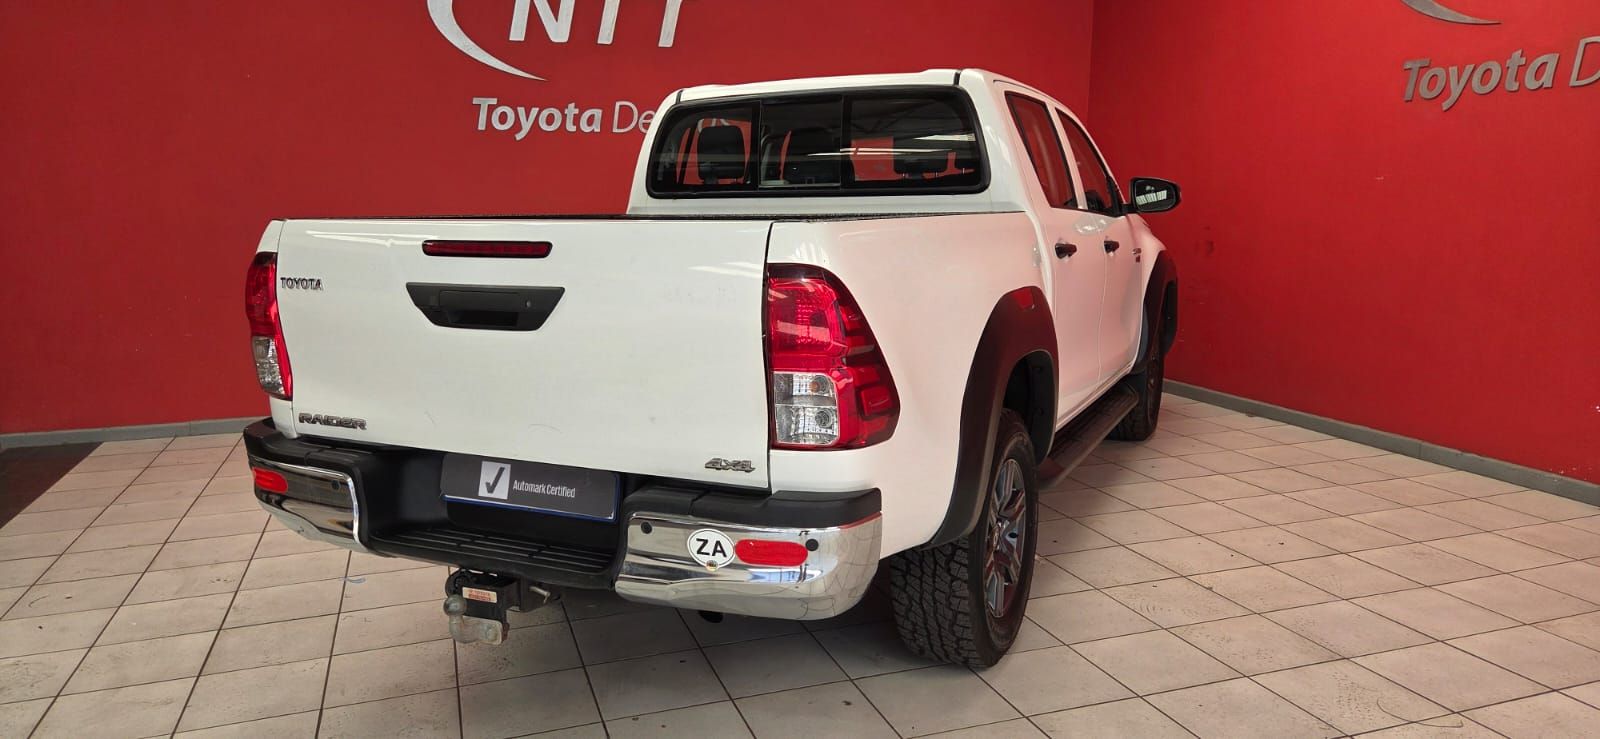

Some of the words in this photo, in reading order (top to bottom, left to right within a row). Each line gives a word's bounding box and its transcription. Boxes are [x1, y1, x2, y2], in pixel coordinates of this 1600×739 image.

[1403, 49, 1560, 112] Toyota
[472, 97, 602, 141] Toyota
[280, 276, 323, 291] TOYOTA
[298, 412, 367, 431] RAIDER
[512, 479, 546, 495] Automark
[546, 483, 576, 498] Certified
[695, 537, 728, 558] ZA
